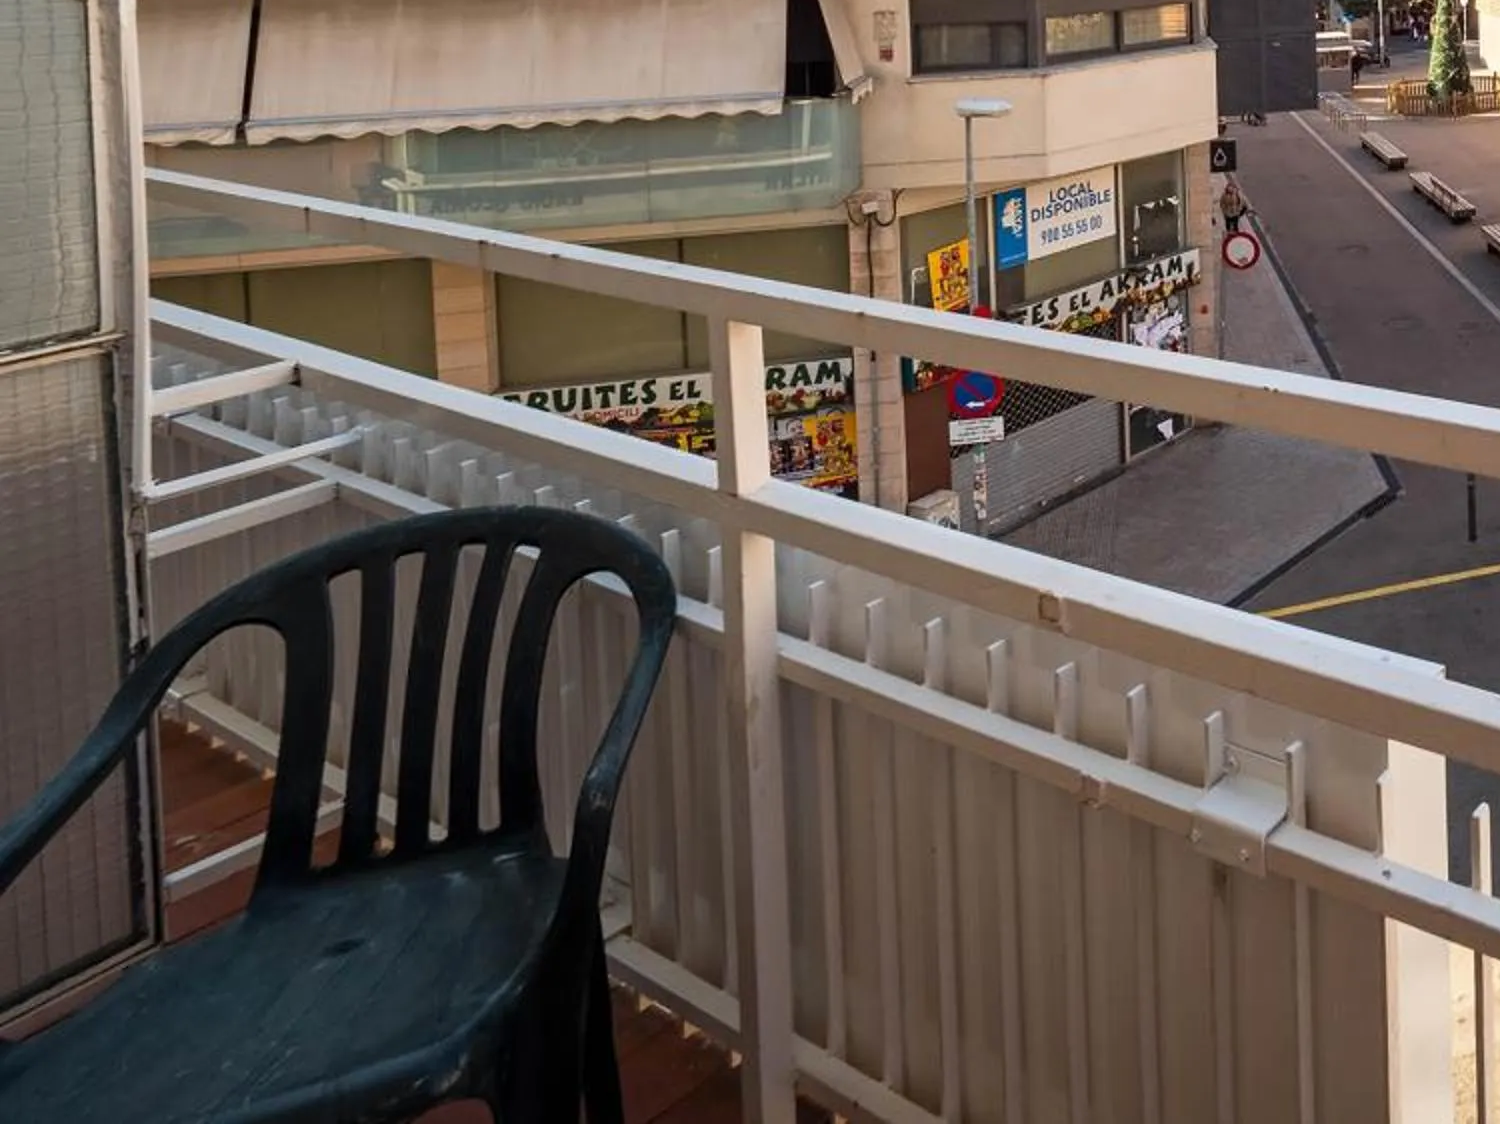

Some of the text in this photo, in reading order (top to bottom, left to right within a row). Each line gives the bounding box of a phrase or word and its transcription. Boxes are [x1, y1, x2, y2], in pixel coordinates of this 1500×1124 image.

[1049, 180, 1094, 203] LOCAL
[1031, 189, 1112, 222] DISPONIBLE
[1062, 221, 1074, 239] 55
[1076, 217, 1089, 235] 55
[1069, 291, 1091, 311] EL
[669, 380, 702, 401] EL
[765, 361, 841, 391] RAM
